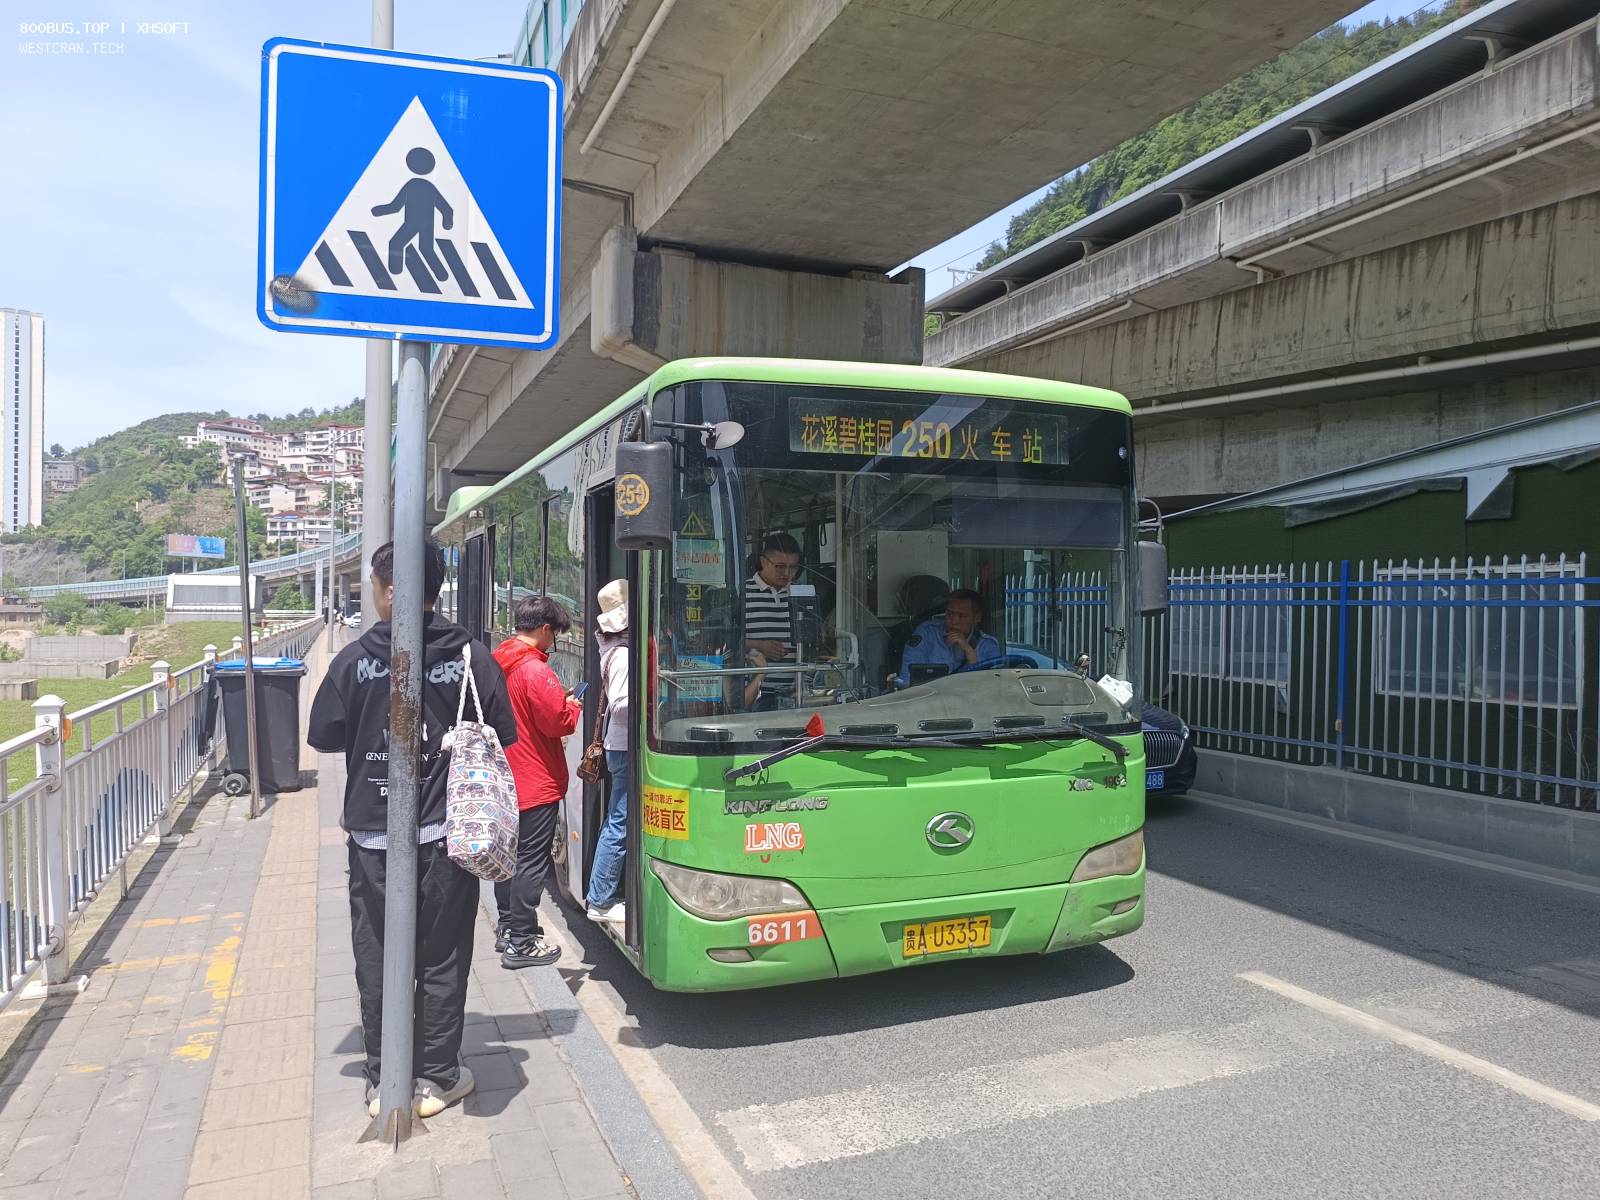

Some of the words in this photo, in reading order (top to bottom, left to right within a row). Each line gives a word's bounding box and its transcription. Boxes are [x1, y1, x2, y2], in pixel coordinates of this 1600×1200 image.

[801, 414, 893, 455] 花溪碧桂园
[901, 419, 951, 458] 250
[960, 424, 1043, 463] 火车站
[776, 796, 828, 812] LONG
[746, 823, 802, 851] LNG
[748, 919, 807, 943] 6611
